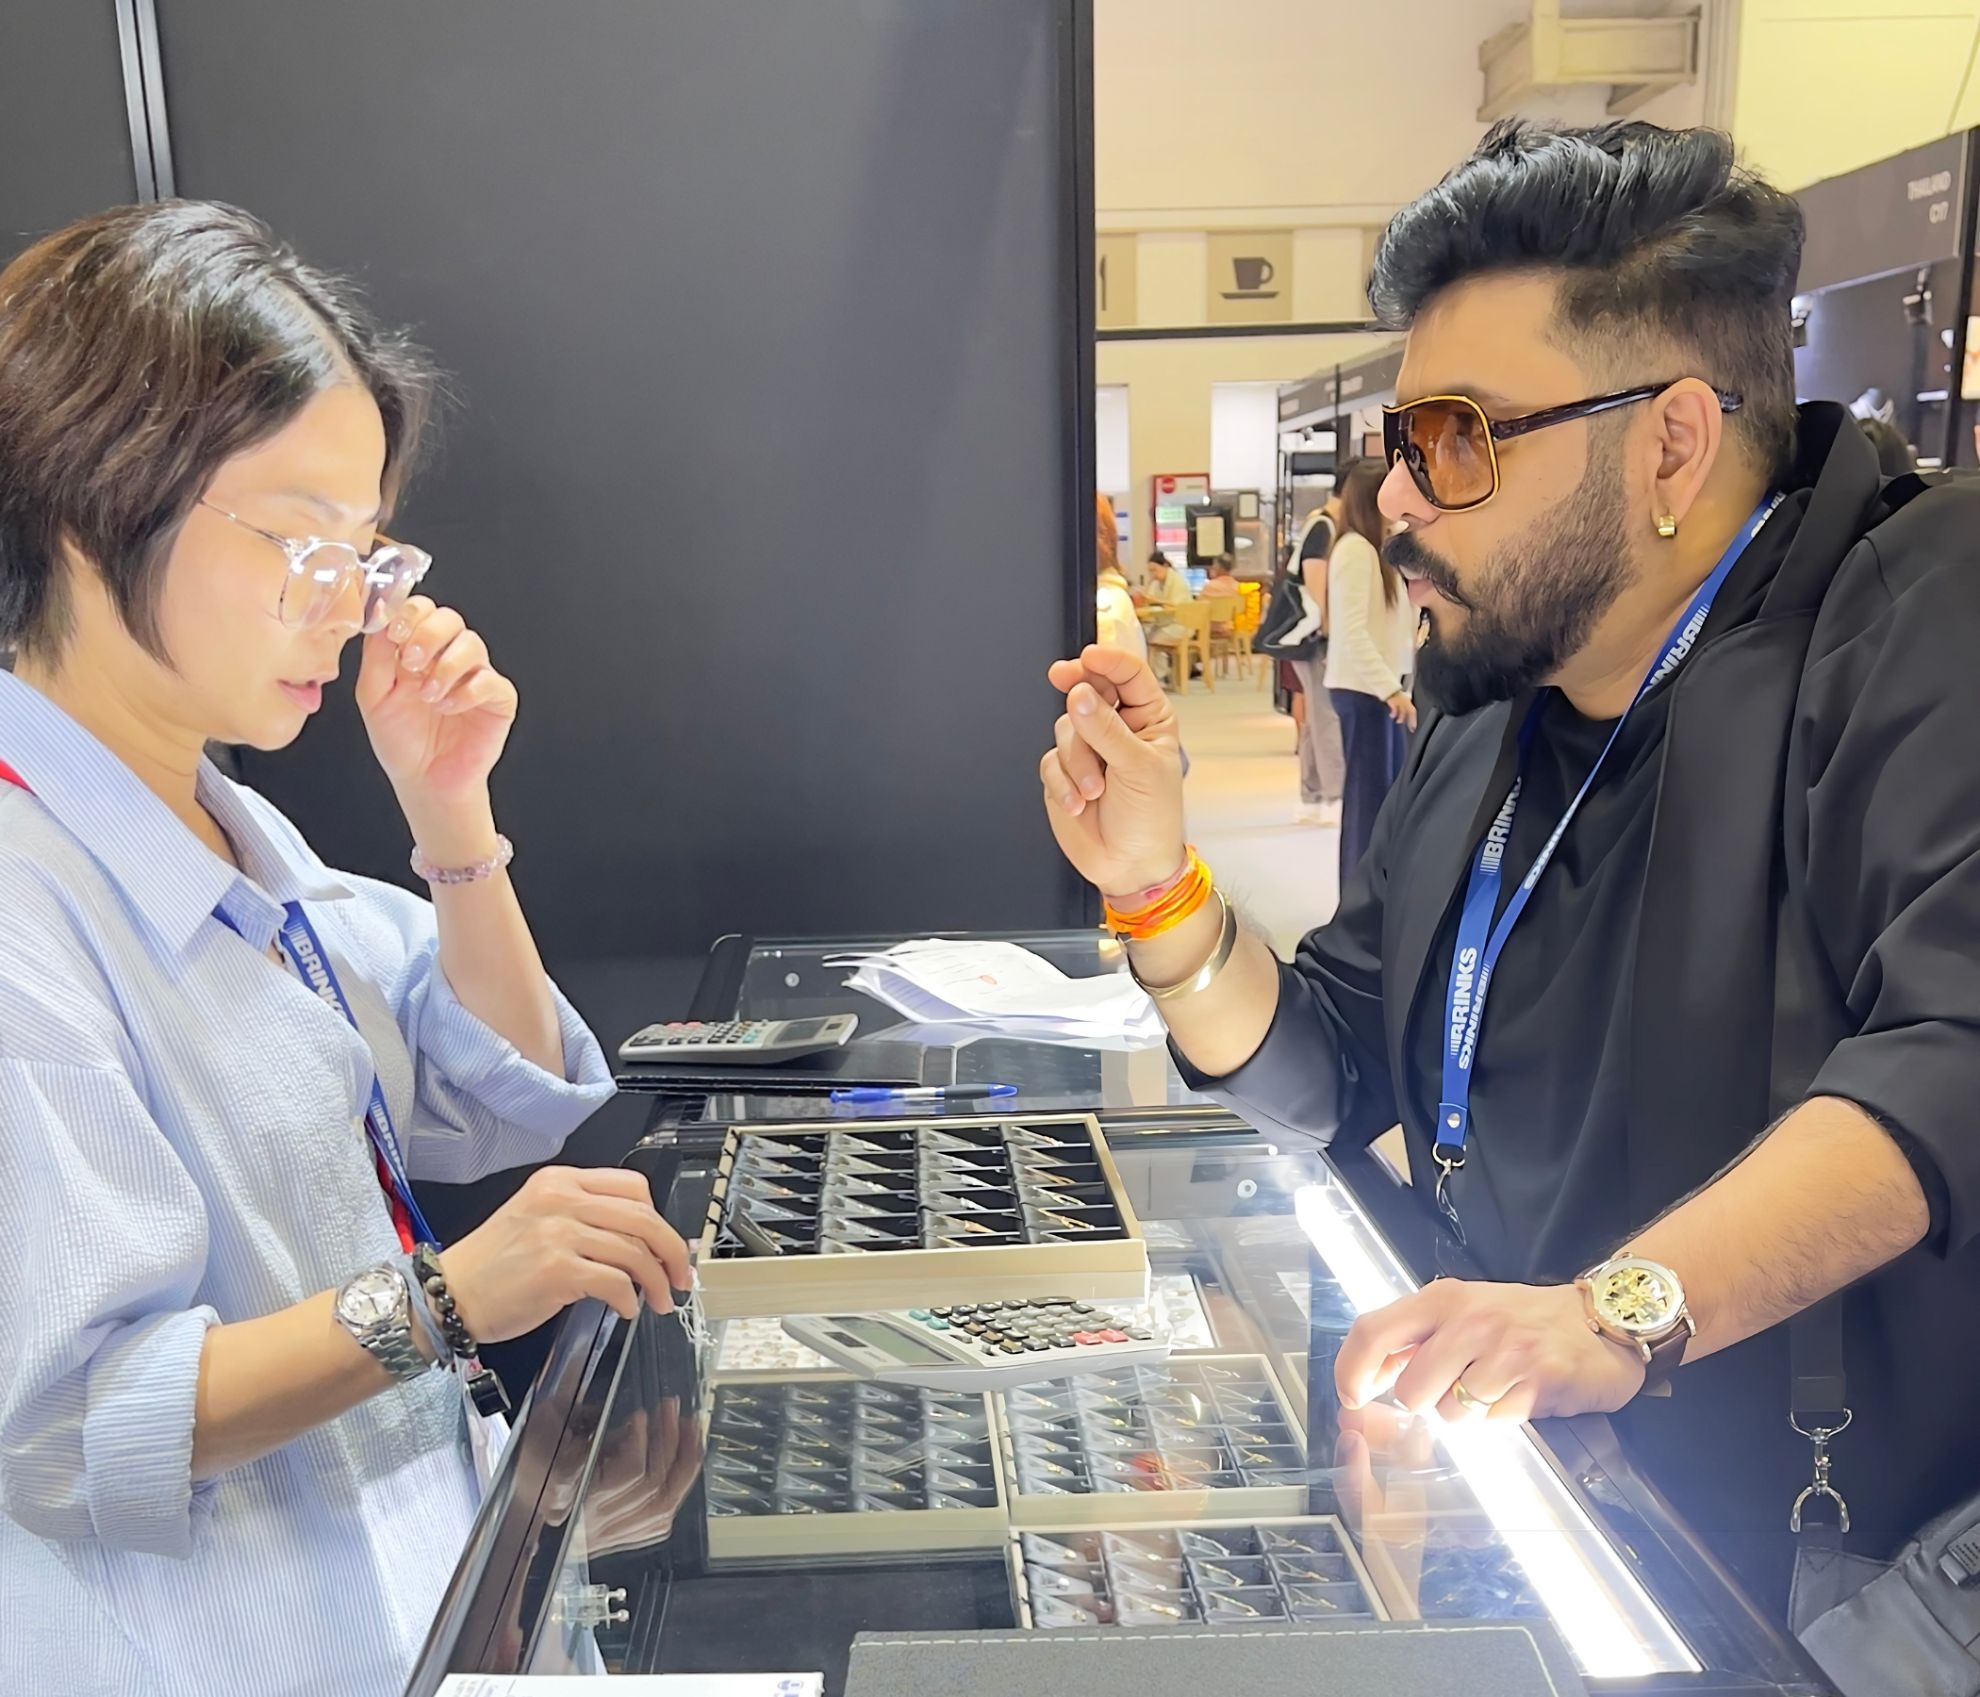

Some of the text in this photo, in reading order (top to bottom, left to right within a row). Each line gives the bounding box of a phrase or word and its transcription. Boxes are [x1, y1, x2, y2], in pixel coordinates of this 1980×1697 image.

[1644, 614, 1703, 690] BRIN
[1484, 776, 1521, 860] BRIN
[1451, 946, 1478, 1042] BRINKS
